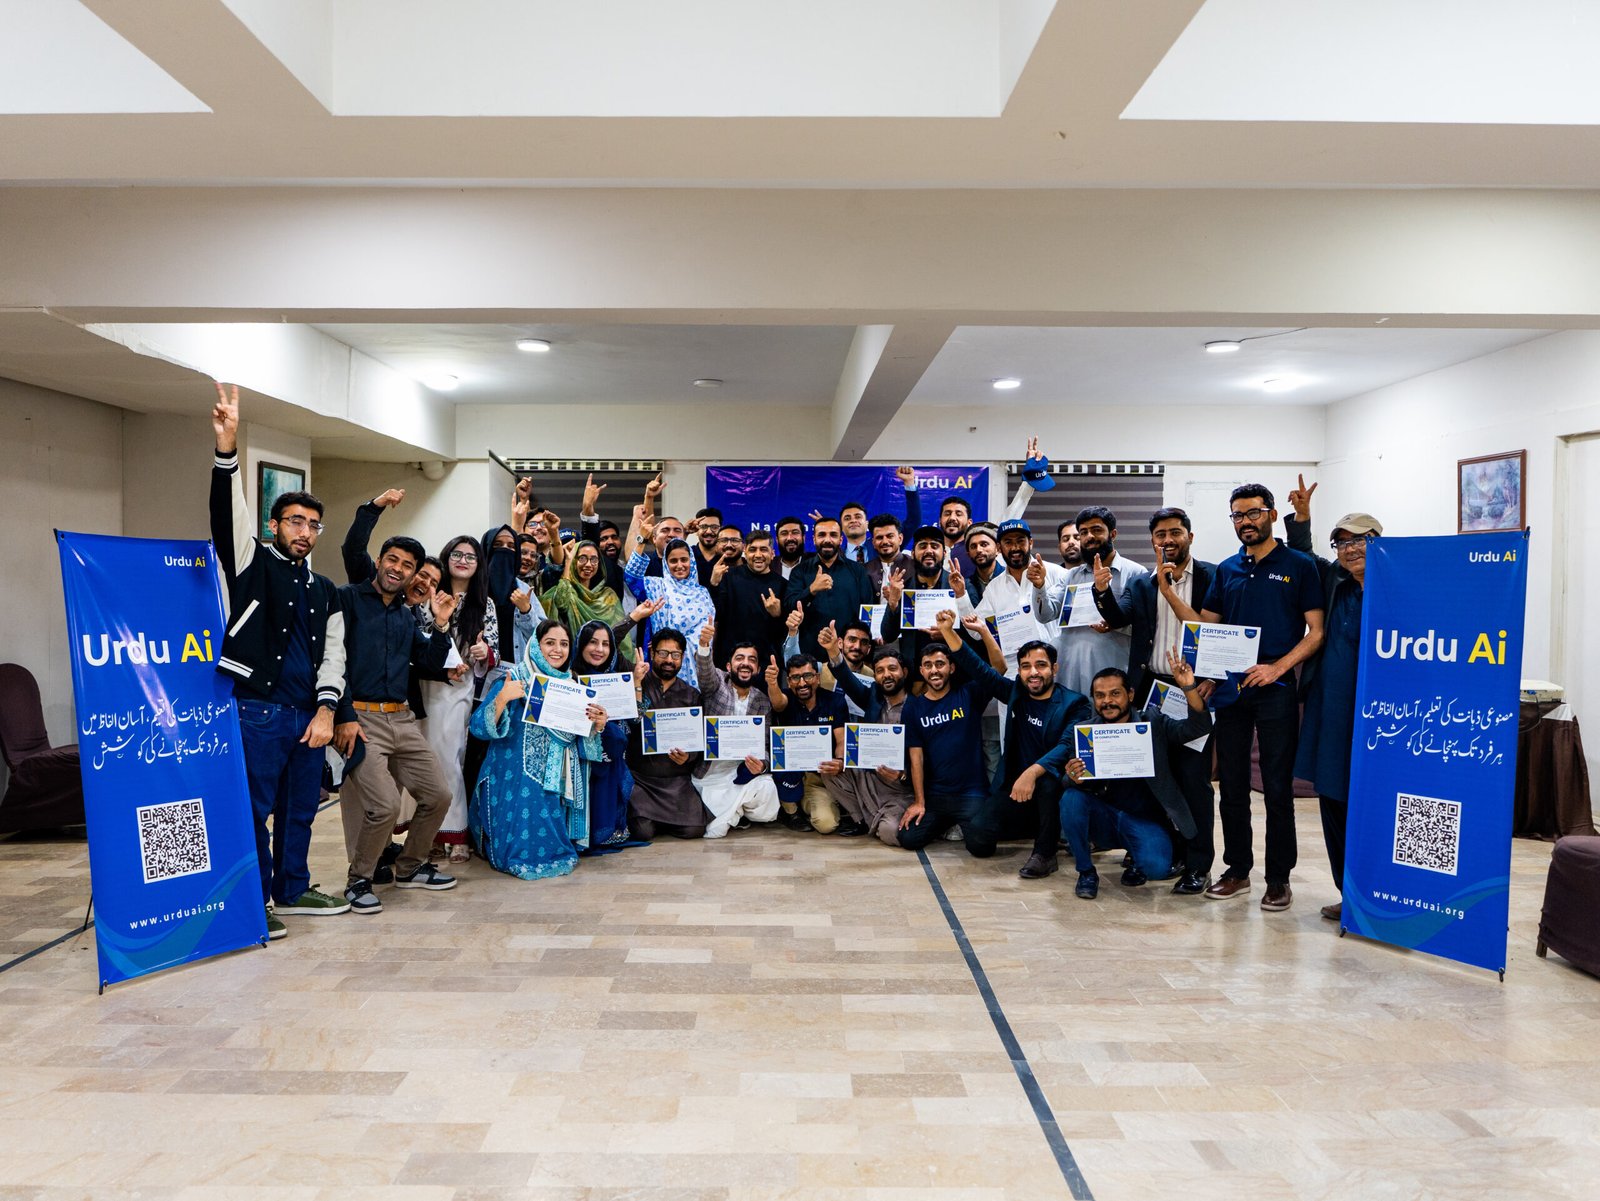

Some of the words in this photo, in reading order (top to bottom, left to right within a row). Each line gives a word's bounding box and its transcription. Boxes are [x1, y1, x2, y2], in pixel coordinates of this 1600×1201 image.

[954, 475, 973, 489] Ai
[164, 555, 192, 567] Urdu
[195, 556, 206, 567] Ai
[1469, 550, 1500, 562] Urdu
[1502, 549, 1517, 561] Ai
[1268, 573, 1283, 581] Urdu
[997, 610, 1021, 622] CERTIFICATE
[1201, 627, 1239, 637] CERTIFICATE
[82, 632, 171, 667] Urdu
[180, 629, 214, 663] Ai
[1375, 629, 1459, 663] Urdu
[1467, 629, 1508, 665] Ai
[549, 681, 582, 695] CERTIFICATE
[118, 704, 146, 730] آسان
[920, 712, 950, 728] Urdu
[951, 706, 965, 721] Ai
[1362, 699, 1378, 719] میں
[1377, 701, 1395, 716] الفاظ
[1394, 699, 1421, 720] آسان
[1440, 697, 1458, 727] کی
[82, 712, 97, 735] میں
[98, 712, 117, 729] الفاظ
[1093, 728, 1131, 736] CERTIFICATE
[1372, 889, 1465, 920] www.urduai.org
[129, 900, 225, 930] www.urduai.org
